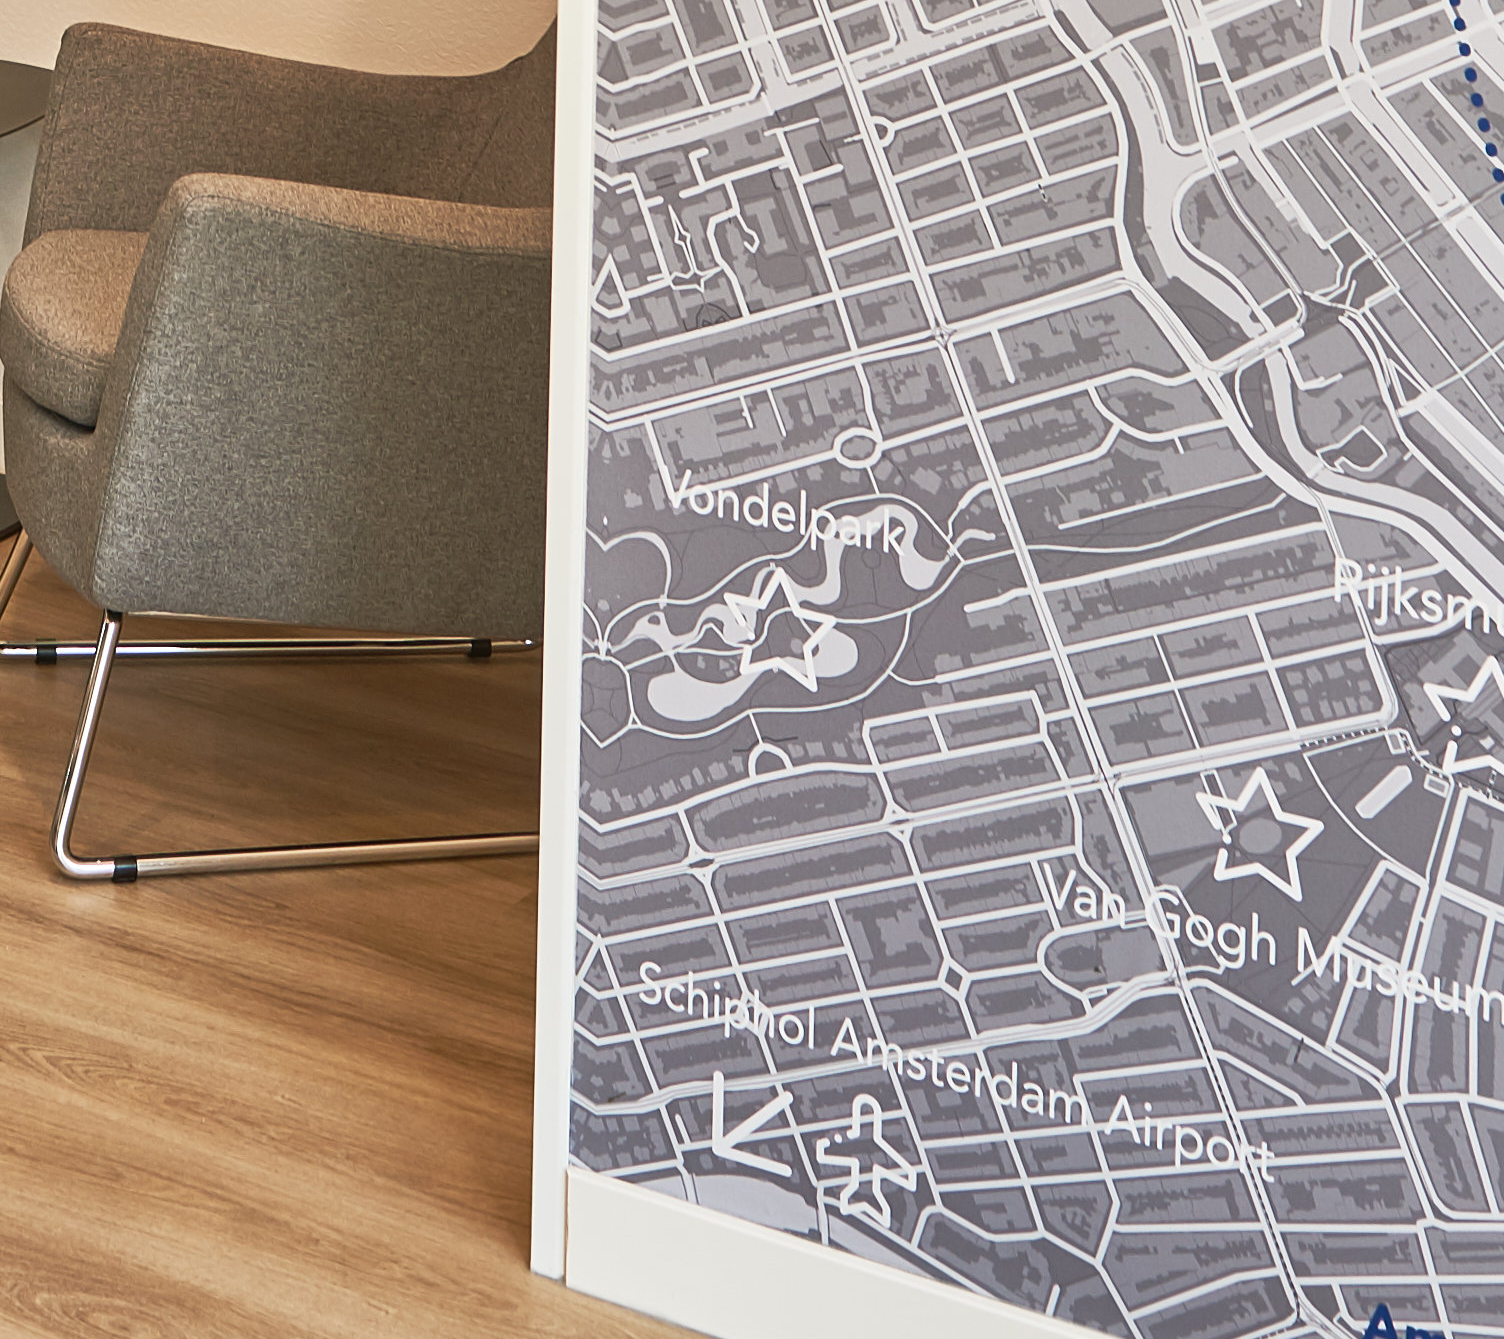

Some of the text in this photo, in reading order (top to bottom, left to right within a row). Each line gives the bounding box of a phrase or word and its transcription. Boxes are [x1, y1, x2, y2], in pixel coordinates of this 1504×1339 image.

[671, 469, 905, 557] Vondelpark
[1040, 863, 1126, 927] Van
[1144, 891, 1277, 966] Gogh
[637, 965, 1276, 1184] Schiphol Amsterdam Airport
